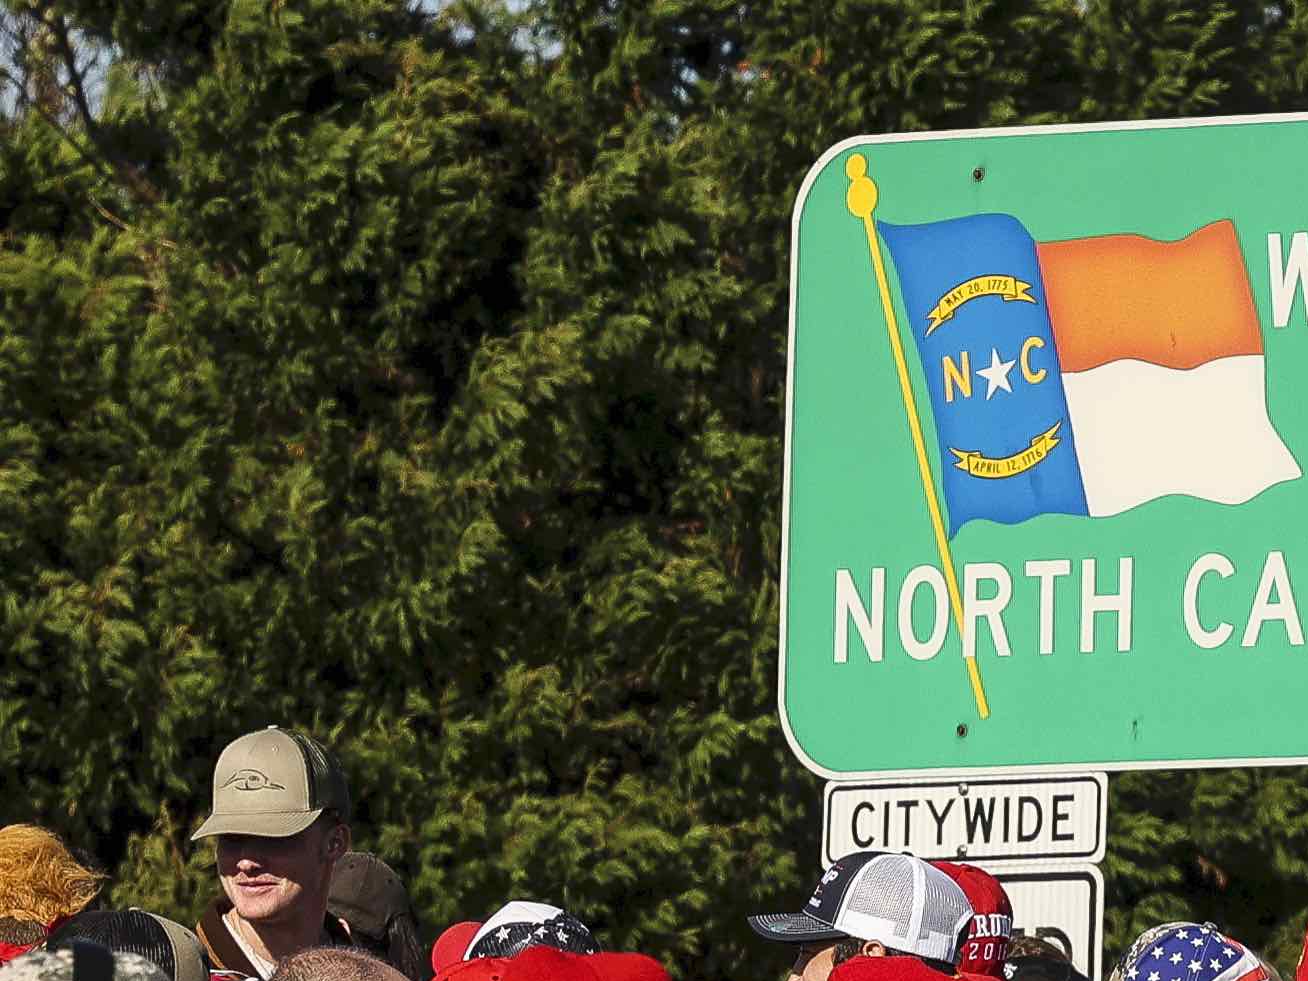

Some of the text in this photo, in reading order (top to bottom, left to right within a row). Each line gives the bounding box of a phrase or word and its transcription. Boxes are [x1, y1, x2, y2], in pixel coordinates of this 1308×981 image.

[944, 287, 963, 306] MAY
[987, 279, 1009, 291] 1775
[943, 336, 1048, 403] N C
[973, 460, 1001, 474] APRIL
[1022, 447, 1042, 466] 1776
[833, 556, 1135, 664] NORTH
[850, 794, 1075, 848] CITYWIDE
